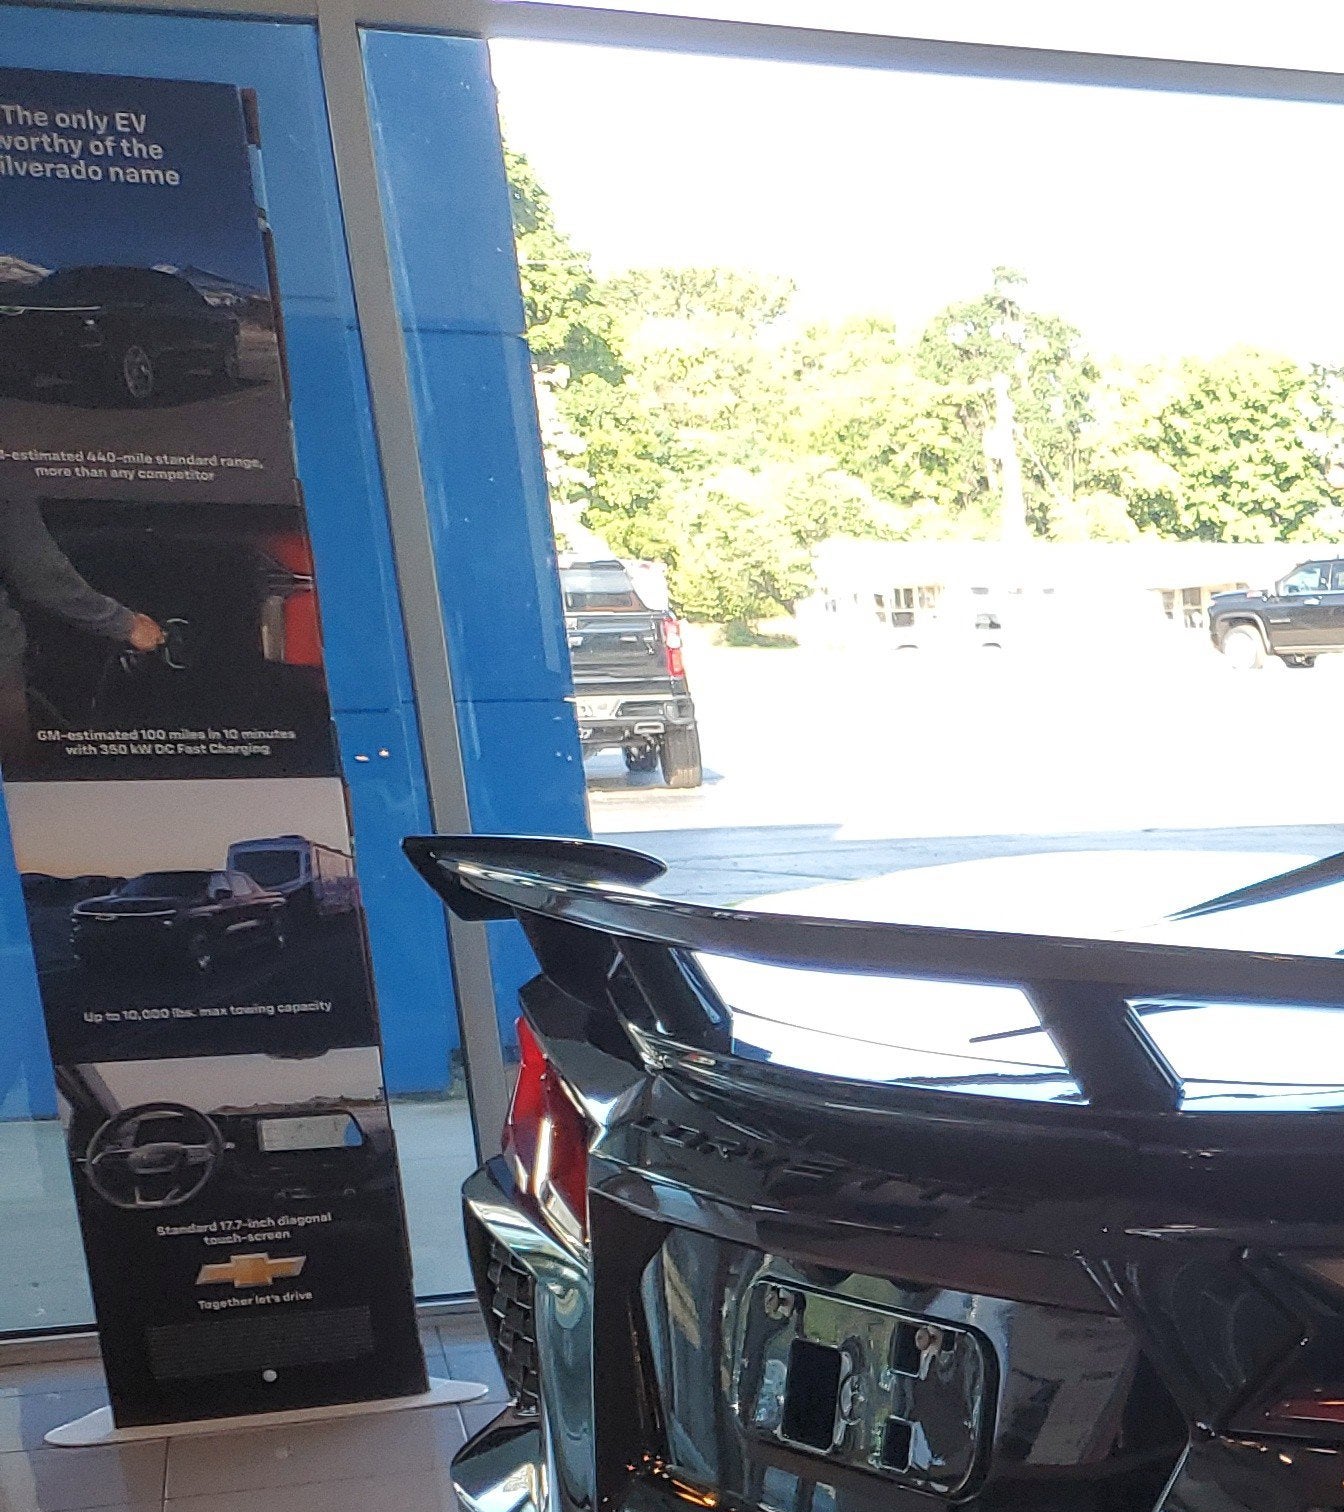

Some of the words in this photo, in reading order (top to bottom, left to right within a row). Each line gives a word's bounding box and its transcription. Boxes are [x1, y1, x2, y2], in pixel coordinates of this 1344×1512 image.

[0, 104, 49, 127] The
[55, 109, 108, 134] only
[115, 112, 147, 134] EV
[89, 136, 117, 157] of
[120, 137, 164, 160] the
[0, 154, 103, 181] ilverado
[108, 165, 181, 186] name
[0, 449, 84, 462] -estimated
[155, 454, 218, 467] standard
[34, 466, 72, 478] more
[74, 466, 107, 478] than
[110, 468, 135, 481] any
[137, 469, 215, 482] competitor
[37, 729, 139, 741] GM-estimated
[140, 729, 166, 741] 100
[169, 728, 206, 740] miles
[208, 727, 221, 740] in
[223, 728, 239, 740] 10
[241, 728, 297, 740] minutes
[65, 743, 98, 755] with
[99, 743, 128, 755] 350
[130, 742, 152, 755] kW
[154, 743, 175, 755] DC
[177, 743, 208, 755] Fast
[209, 742, 271, 757] Charging
[83, 1011, 103, 1023] Up
[105, 1012, 121, 1022] to
[199, 1007, 228, 1017] max
[229, 1004, 275, 1016] towing
[277, 1000, 332, 1014] capacity
[156, 1221, 217, 1236] Standard
[277, 1211, 332, 1227] diagonal
[203, 1230, 291, 1246] touch-screen
[198, 1297, 253, 1311] Together
[255, 1294, 280, 1305] let's
[282, 1291, 313, 1302] drive
